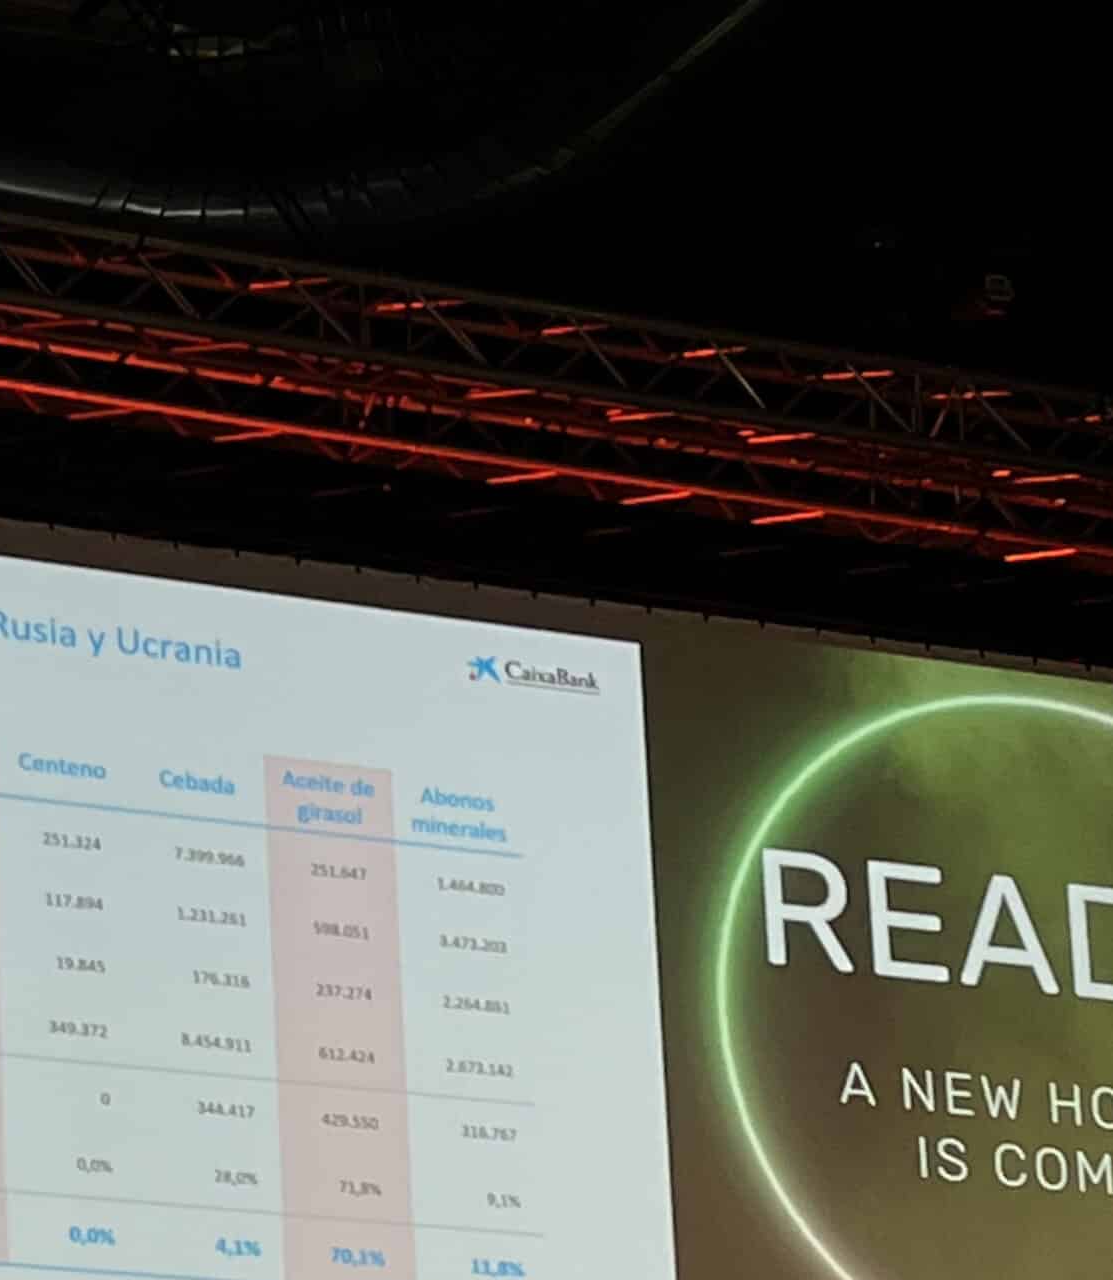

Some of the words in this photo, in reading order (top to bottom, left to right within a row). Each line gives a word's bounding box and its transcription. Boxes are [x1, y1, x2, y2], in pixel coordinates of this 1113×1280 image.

[87, 630, 106, 657] y
[117, 626, 242, 670] Ucrania
[504, 660, 599, 690] CaixaBank
[18, 752, 107, 780] Centeno
[159, 769, 236, 795] Cebada
[282, 770, 344, 795] Aceite
[350, 777, 375, 798] de
[420, 786, 495, 813] Abonos
[297, 802, 363, 825] girasol
[411, 816, 507, 843] minerales
[100, 1092, 111, 1108] 0
[840, 1061, 877, 1107] A
[901, 1066, 1020, 1121] NEW
[76, 1157, 114, 1175] 0,0%
[918, 1135, 969, 1182] IS
[993, 1142, 1113, 1196] COM
[486, 1192, 522, 1210] 9,1%
[69, 1226, 116, 1249] 0,0%
[215, 1237, 263, 1259] 4,1%
[331, 1246, 387, 1269] 70,1%
